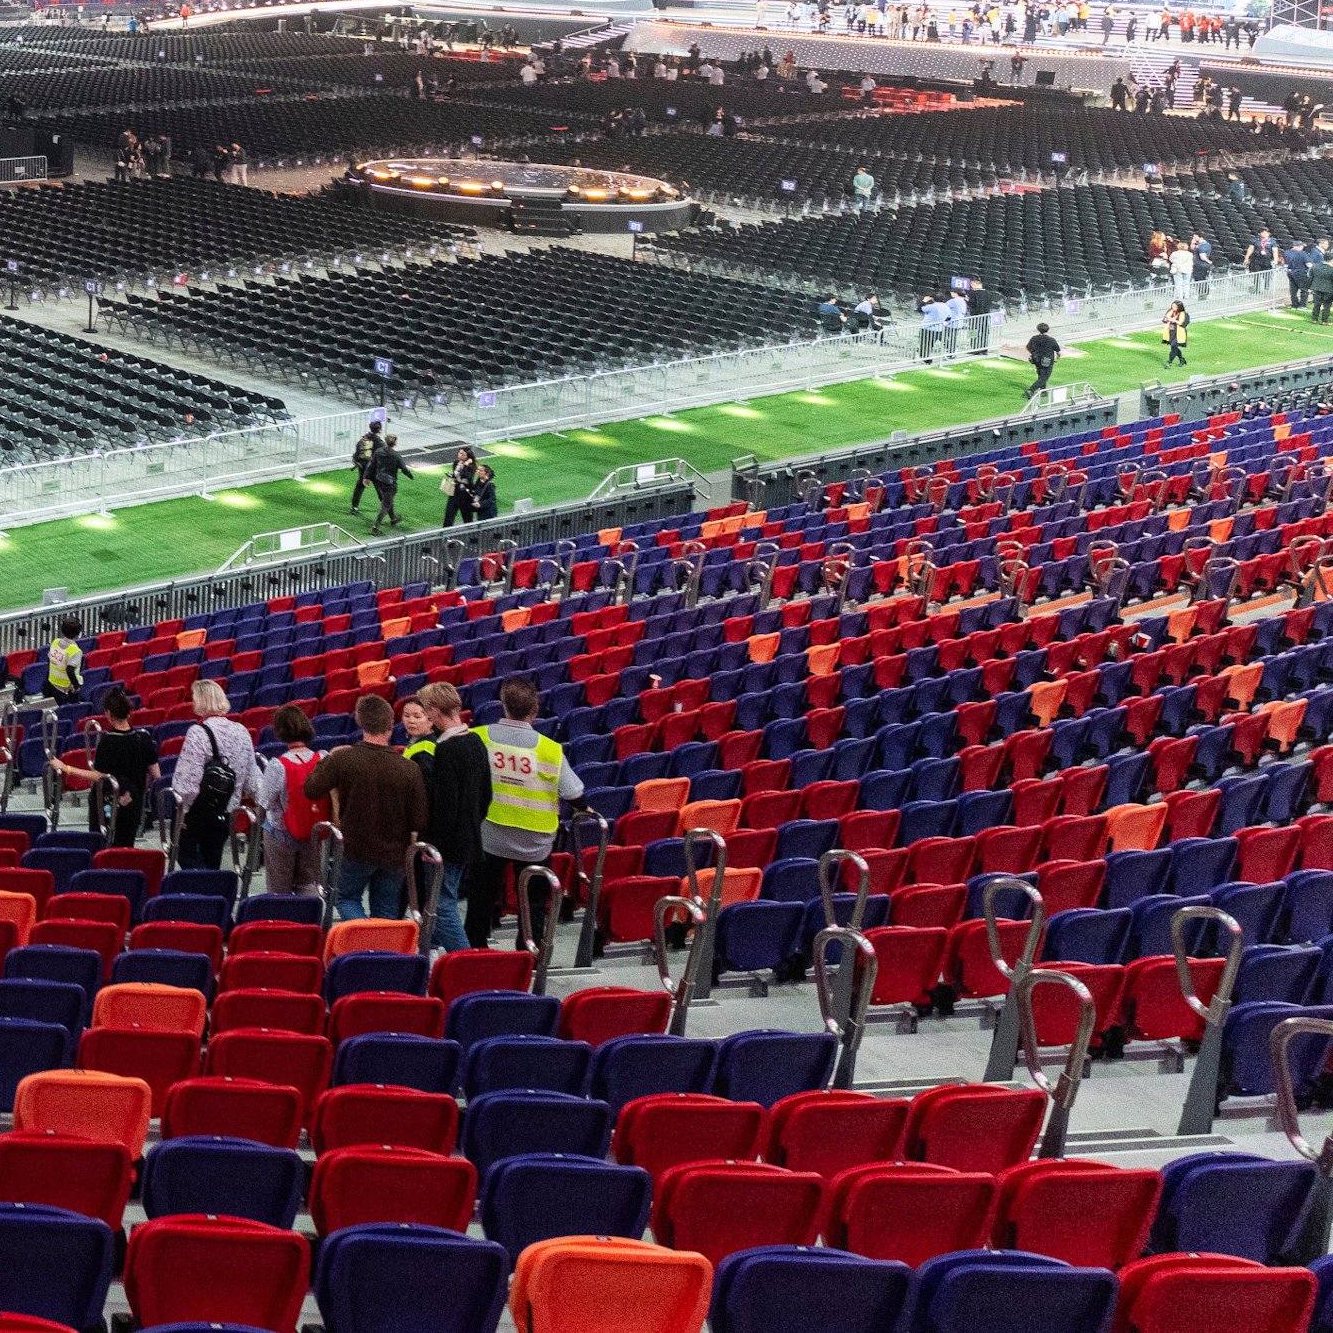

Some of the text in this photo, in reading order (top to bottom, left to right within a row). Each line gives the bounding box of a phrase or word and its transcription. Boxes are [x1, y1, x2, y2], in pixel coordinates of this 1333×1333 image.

[955, 279, 968, 287] B1
[378, 361, 389, 373] C1
[494, 752, 531, 774] 313
